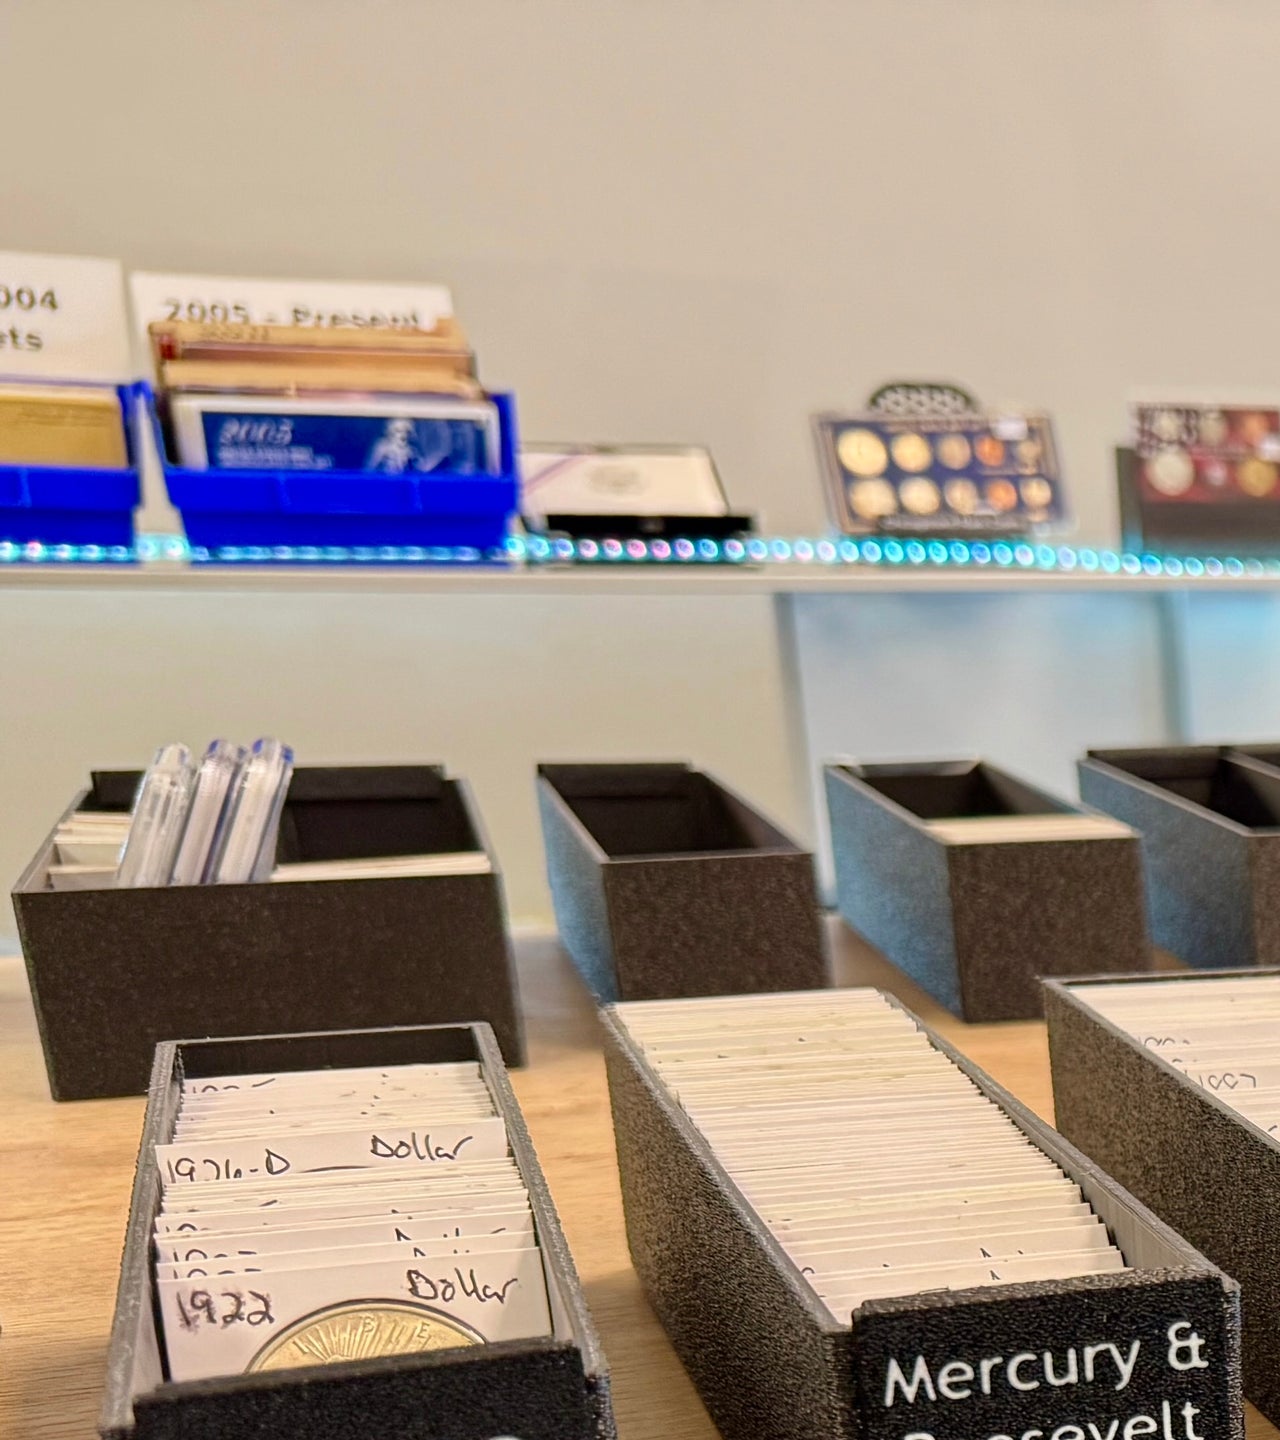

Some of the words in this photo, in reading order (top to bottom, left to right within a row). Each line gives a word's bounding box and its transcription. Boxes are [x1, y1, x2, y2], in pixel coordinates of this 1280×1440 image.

[370, 1131, 474, 1162] Dollar
[176, 1289, 275, 1326] 1922
[407, 1267, 519, 1304] Dollar
[885, 1340, 1141, 1408] Mercury
[1166, 1321, 1209, 1371] &
